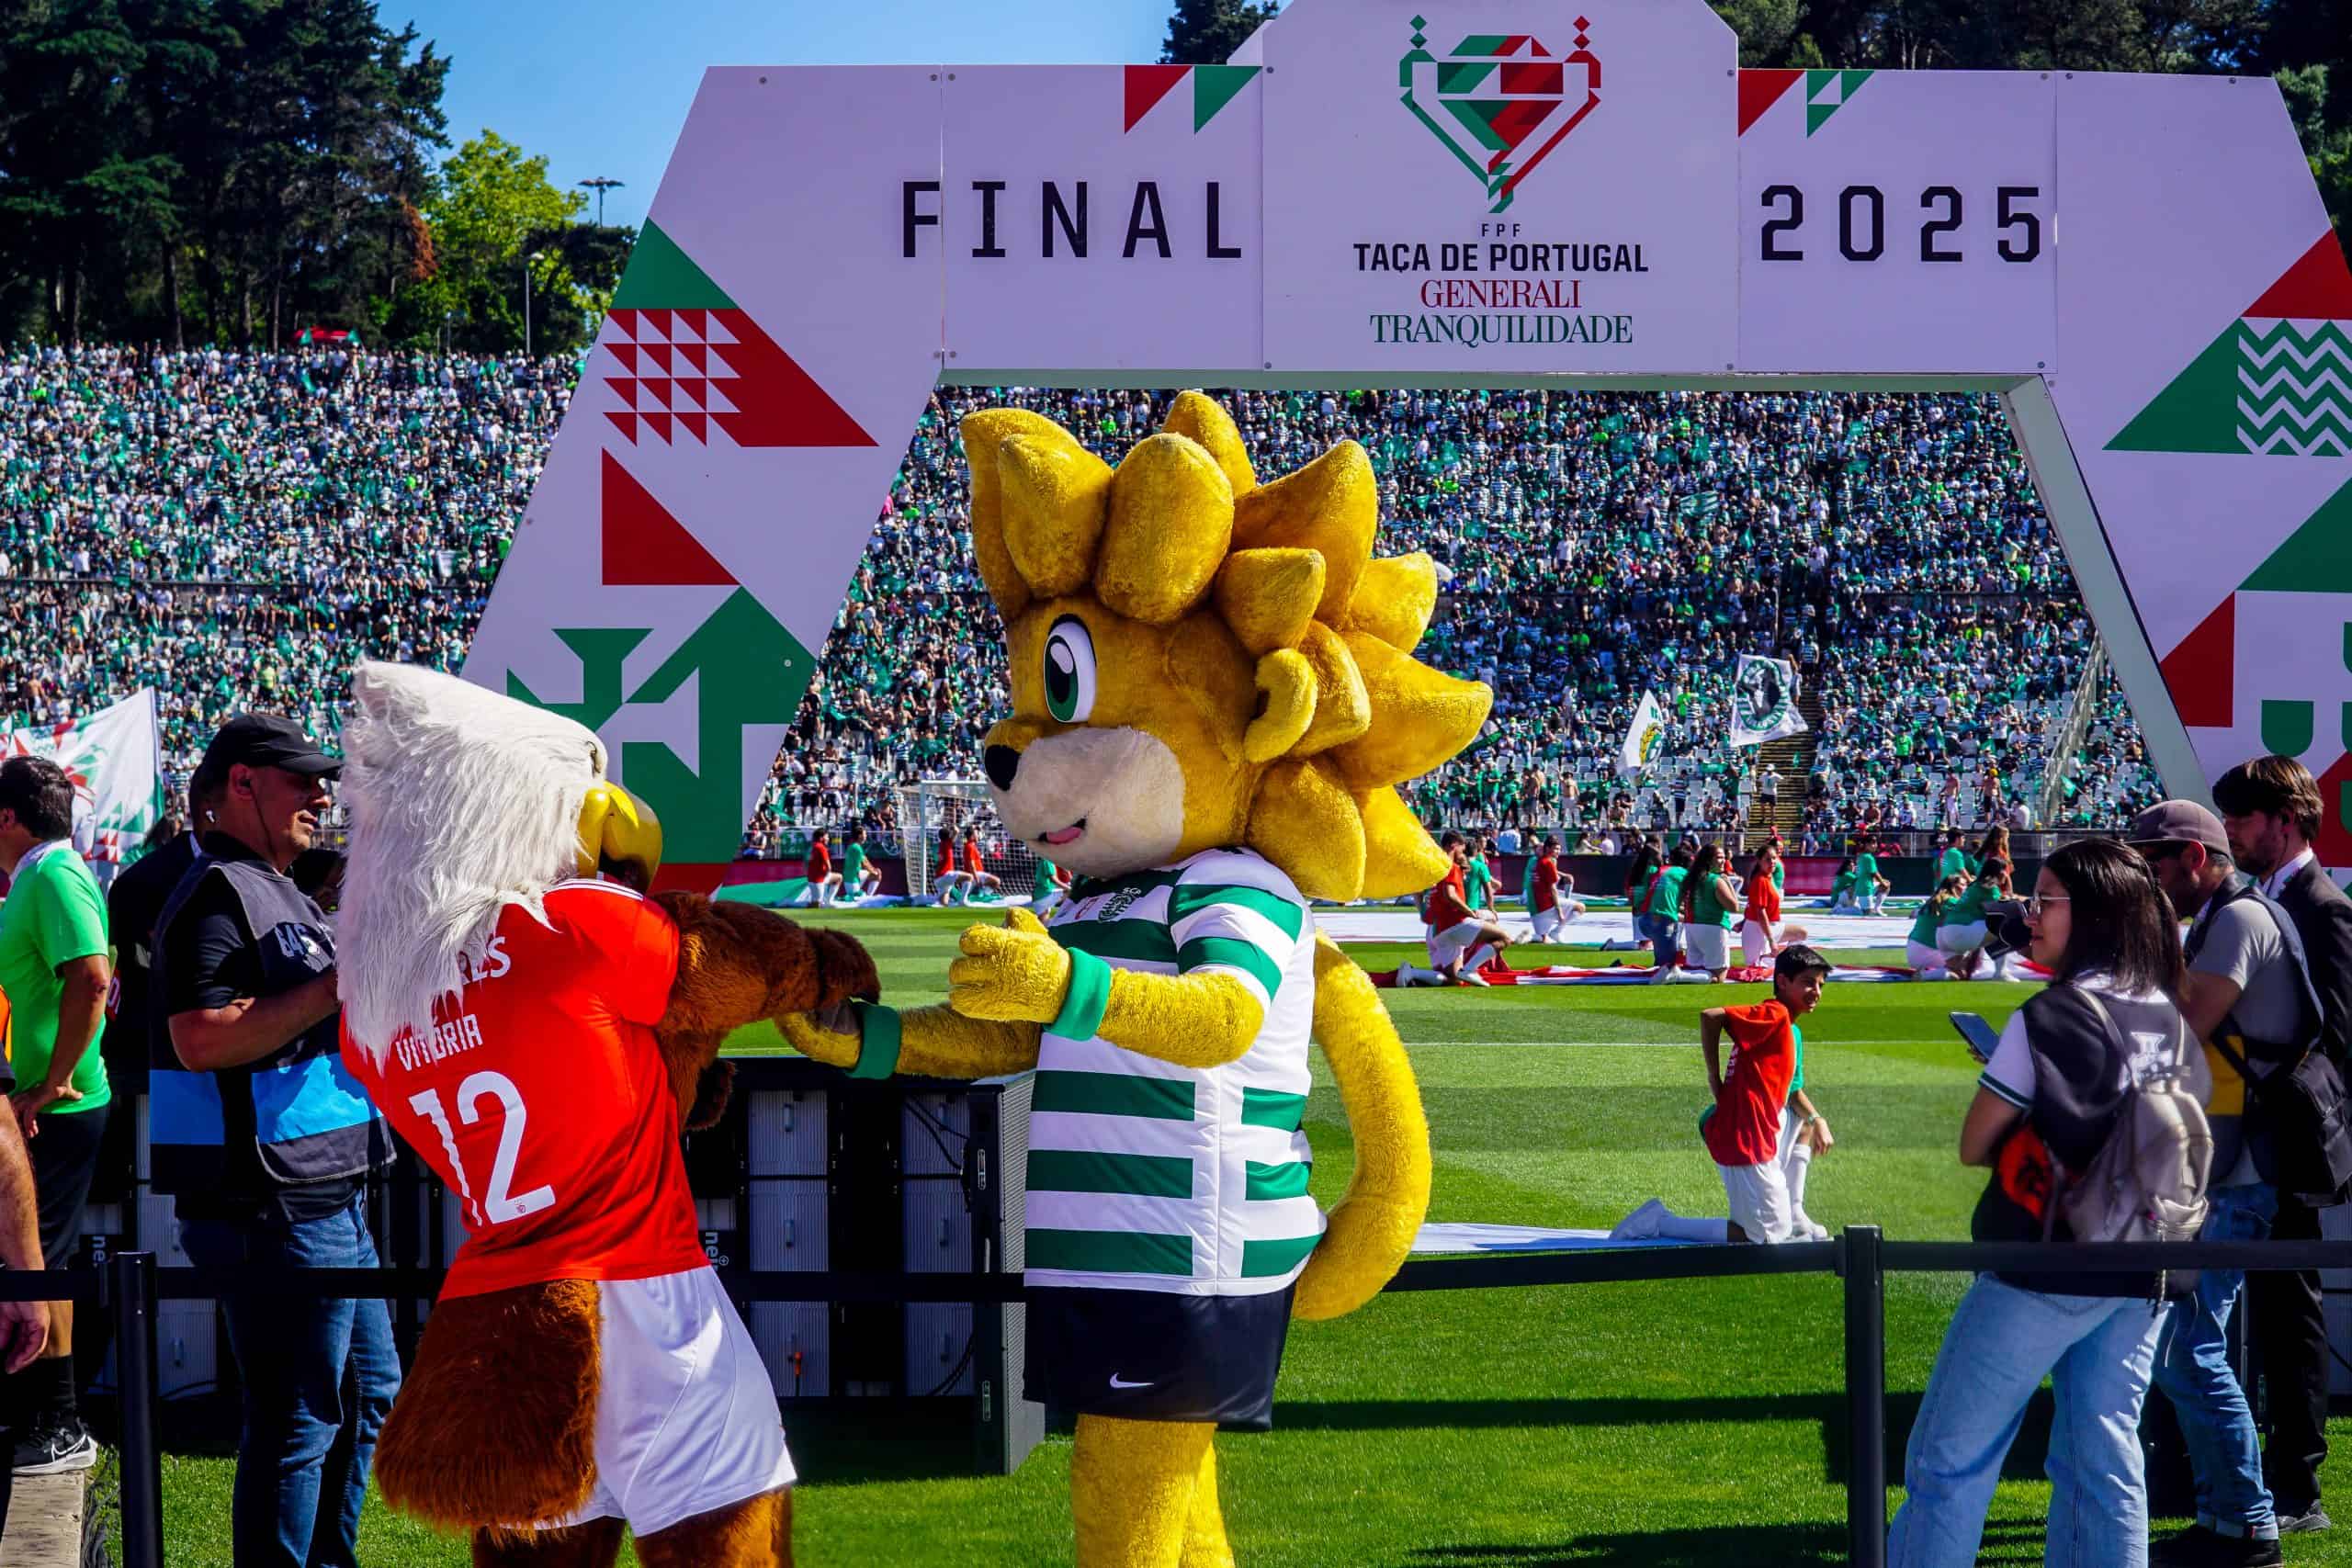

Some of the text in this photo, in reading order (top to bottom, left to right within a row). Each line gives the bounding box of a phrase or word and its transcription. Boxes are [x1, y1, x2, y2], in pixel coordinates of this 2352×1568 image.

[902, 180, 1243, 259] FINAL
[1480, 222, 1521, 238] FPF
[1760, 185, 2041, 263] 2025
[1352, 243, 1650, 274] TAÇA DE PORTUGAL
[1420, 278, 1583, 309] GENERALI
[1370, 313, 1634, 349] TRANQUILIDADE
[408, 1070, 556, 1226] 12
